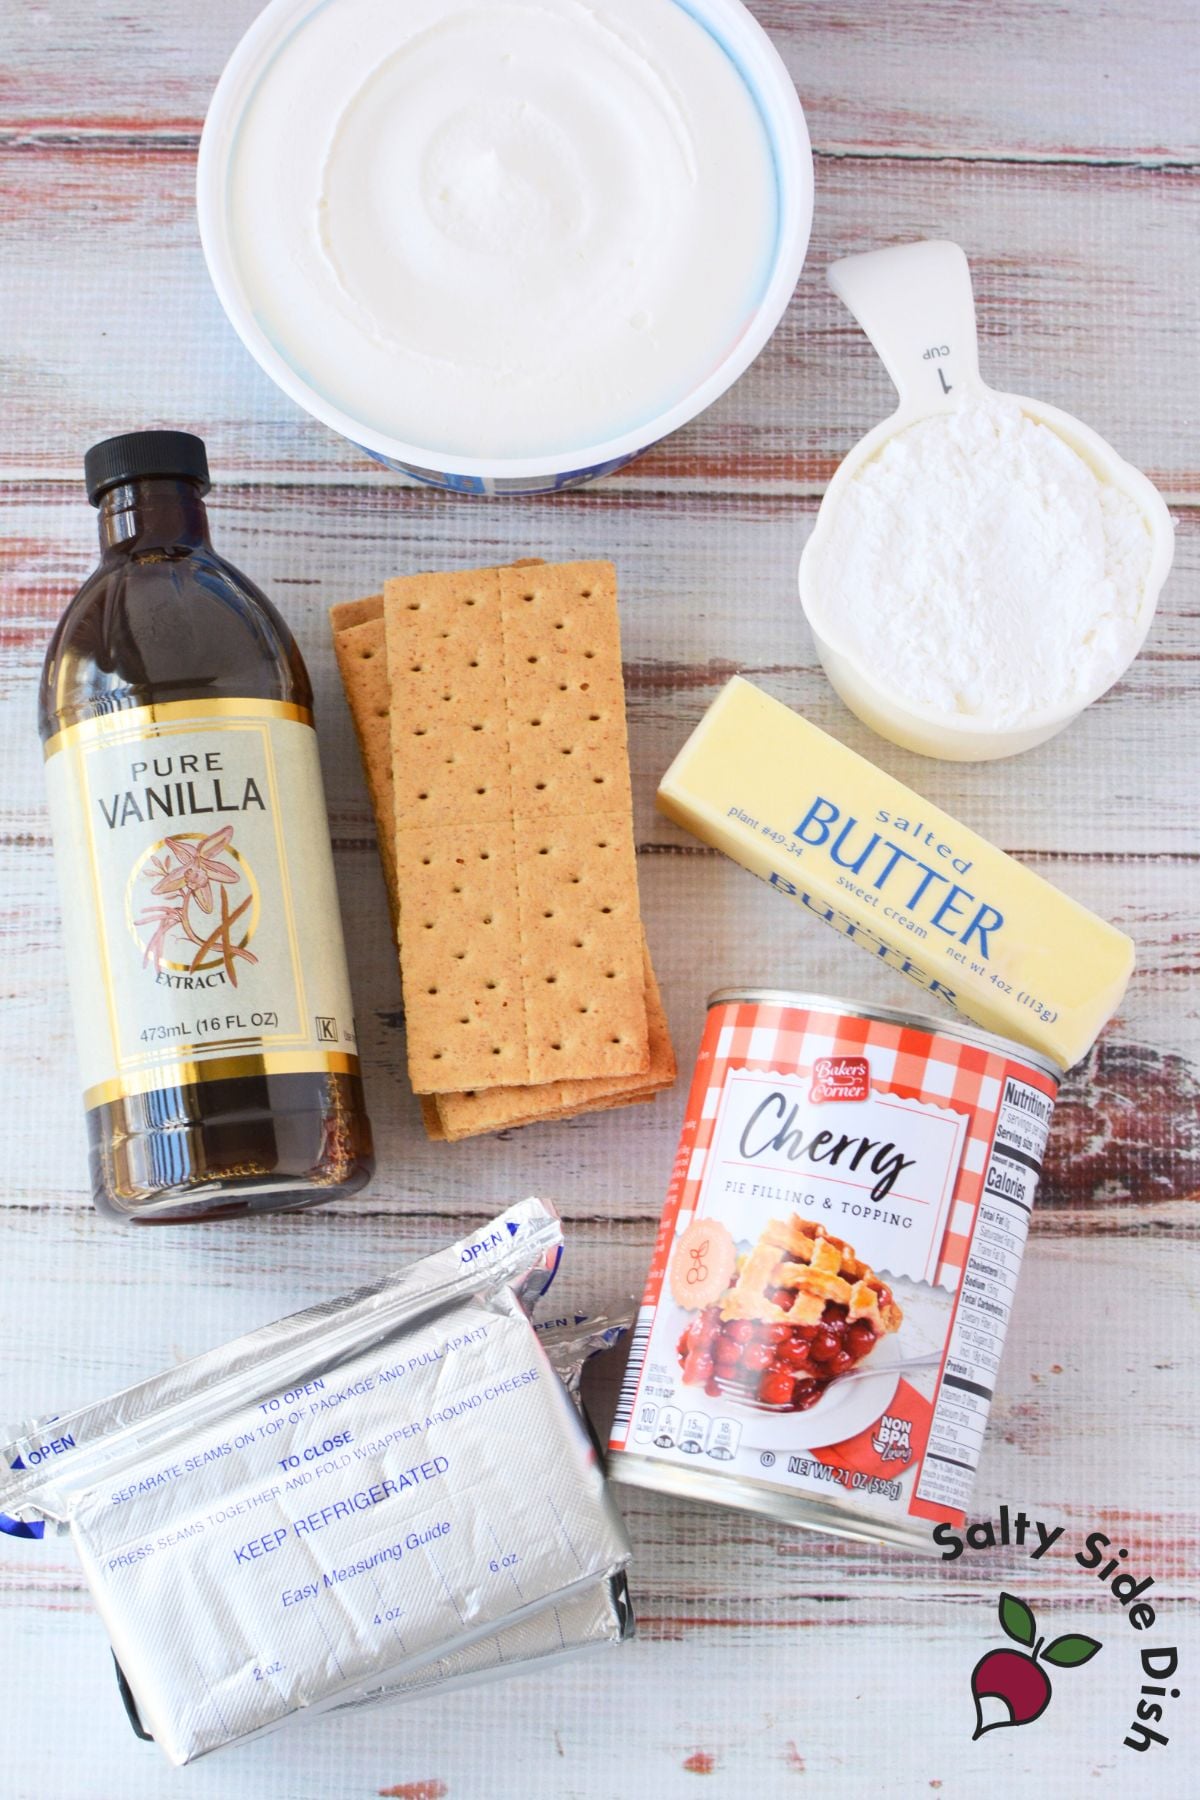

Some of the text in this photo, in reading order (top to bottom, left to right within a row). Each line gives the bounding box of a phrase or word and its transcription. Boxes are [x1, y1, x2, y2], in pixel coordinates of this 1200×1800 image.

[922, 345, 950, 360] CUP
[938, 368, 952, 394] 1
[131, 752, 224, 782] PURE
[98, 777, 266, 829] VANILLA
[727, 807, 804, 857] plant #49-34
[875, 809, 974, 875] salted
[792, 796, 1004, 961] BUTTER
[836, 874, 929, 939] sweet cream
[769, 872, 958, 1006] BUTTER
[155, 971, 228, 990] EXTRACT
[946, 947, 1058, 1024] net wt 4oz (113g)
[140, 1013, 278, 1042] 473mL (16 FL OZ)
[816, 1060, 866, 1078] Baker's
[811, 1084, 864, 1102] Corner
[1004, 1082, 1046, 1120] Nutrition
[739, 1092, 917, 1203] Cherry
[986, 1166, 1026, 1200] Calories
[724, 1180, 913, 1229] PIE FILLING & TOPPING
[461, 1231, 503, 1263] OPEN
[533, 1318, 568, 1332] PEN
[259, 1379, 325, 1415] TO OPEN
[111, 1327, 488, 1505] SEPARATE SEAMS ON TOP OF PACKAGE AND PULL APART
[640, 1407, 656, 1424] 100
[881, 1415, 912, 1434] NON
[28, 1434, 77, 1465] OPEN
[278, 1430, 354, 1472] TO CLOSE
[878, 1427, 911, 1449] BPA
[881, 1444, 913, 1464] Lining
[109, 1368, 540, 1572] PRESS SEAMS TOGETHER AND FOLD WRAPPER AROUND CHEESE
[788, 1456, 814, 1477] NET
[813, 1461, 834, 1482] WT
[834, 1469, 850, 1487] 21
[852, 1474, 868, 1491] OZ
[868, 1478, 903, 1501] (595g)
[233, 1456, 450, 1565] KEEP REFRIGERATED
[281, 1521, 451, 1607] Easy Measuring Guide
[489, 1552, 523, 1573] 6 oz.
[373, 1614, 382, 1625] 4
[253, 1659, 287, 1681] 2 oz.
